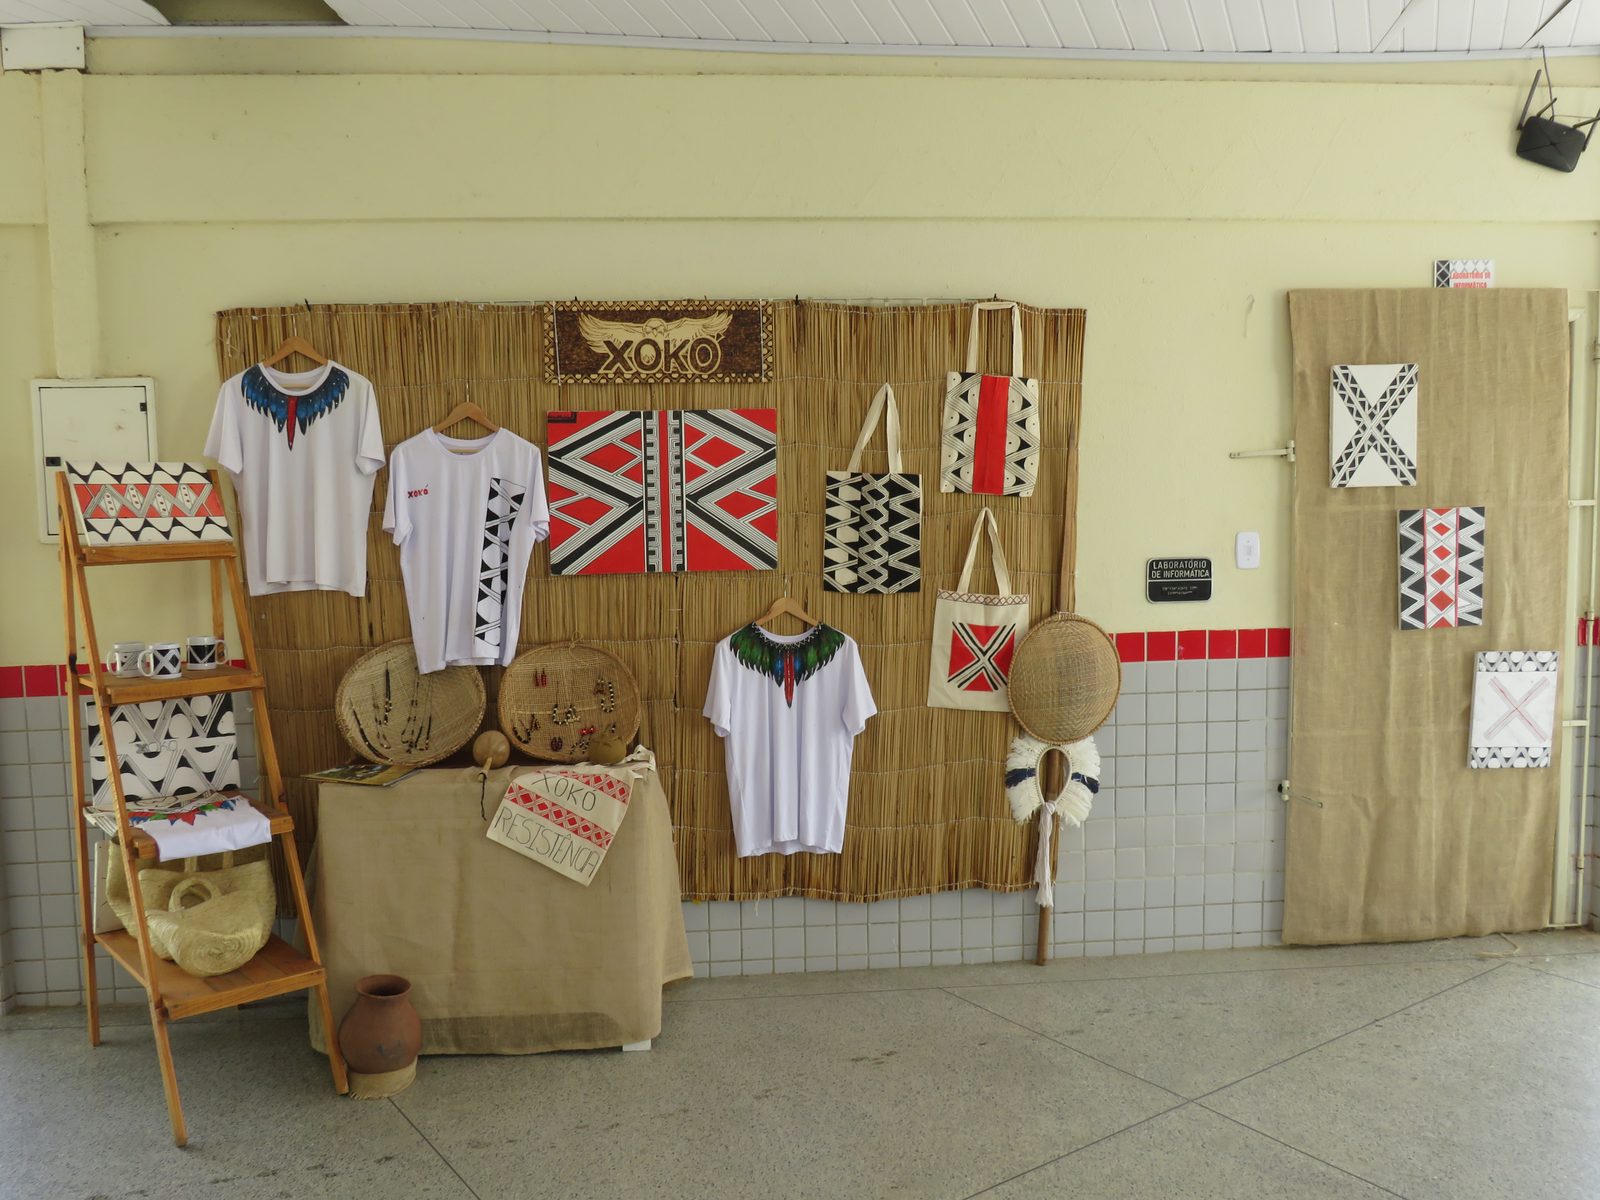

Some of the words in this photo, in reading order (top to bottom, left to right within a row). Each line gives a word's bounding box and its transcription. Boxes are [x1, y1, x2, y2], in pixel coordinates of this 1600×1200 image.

[1153, 560, 1207, 570] LABORATÓRIO
[1151, 570, 1161, 579] DE
[1163, 568, 1210, 578] INFORMÁTICA
[531, 773, 597, 812] XOKÓ
